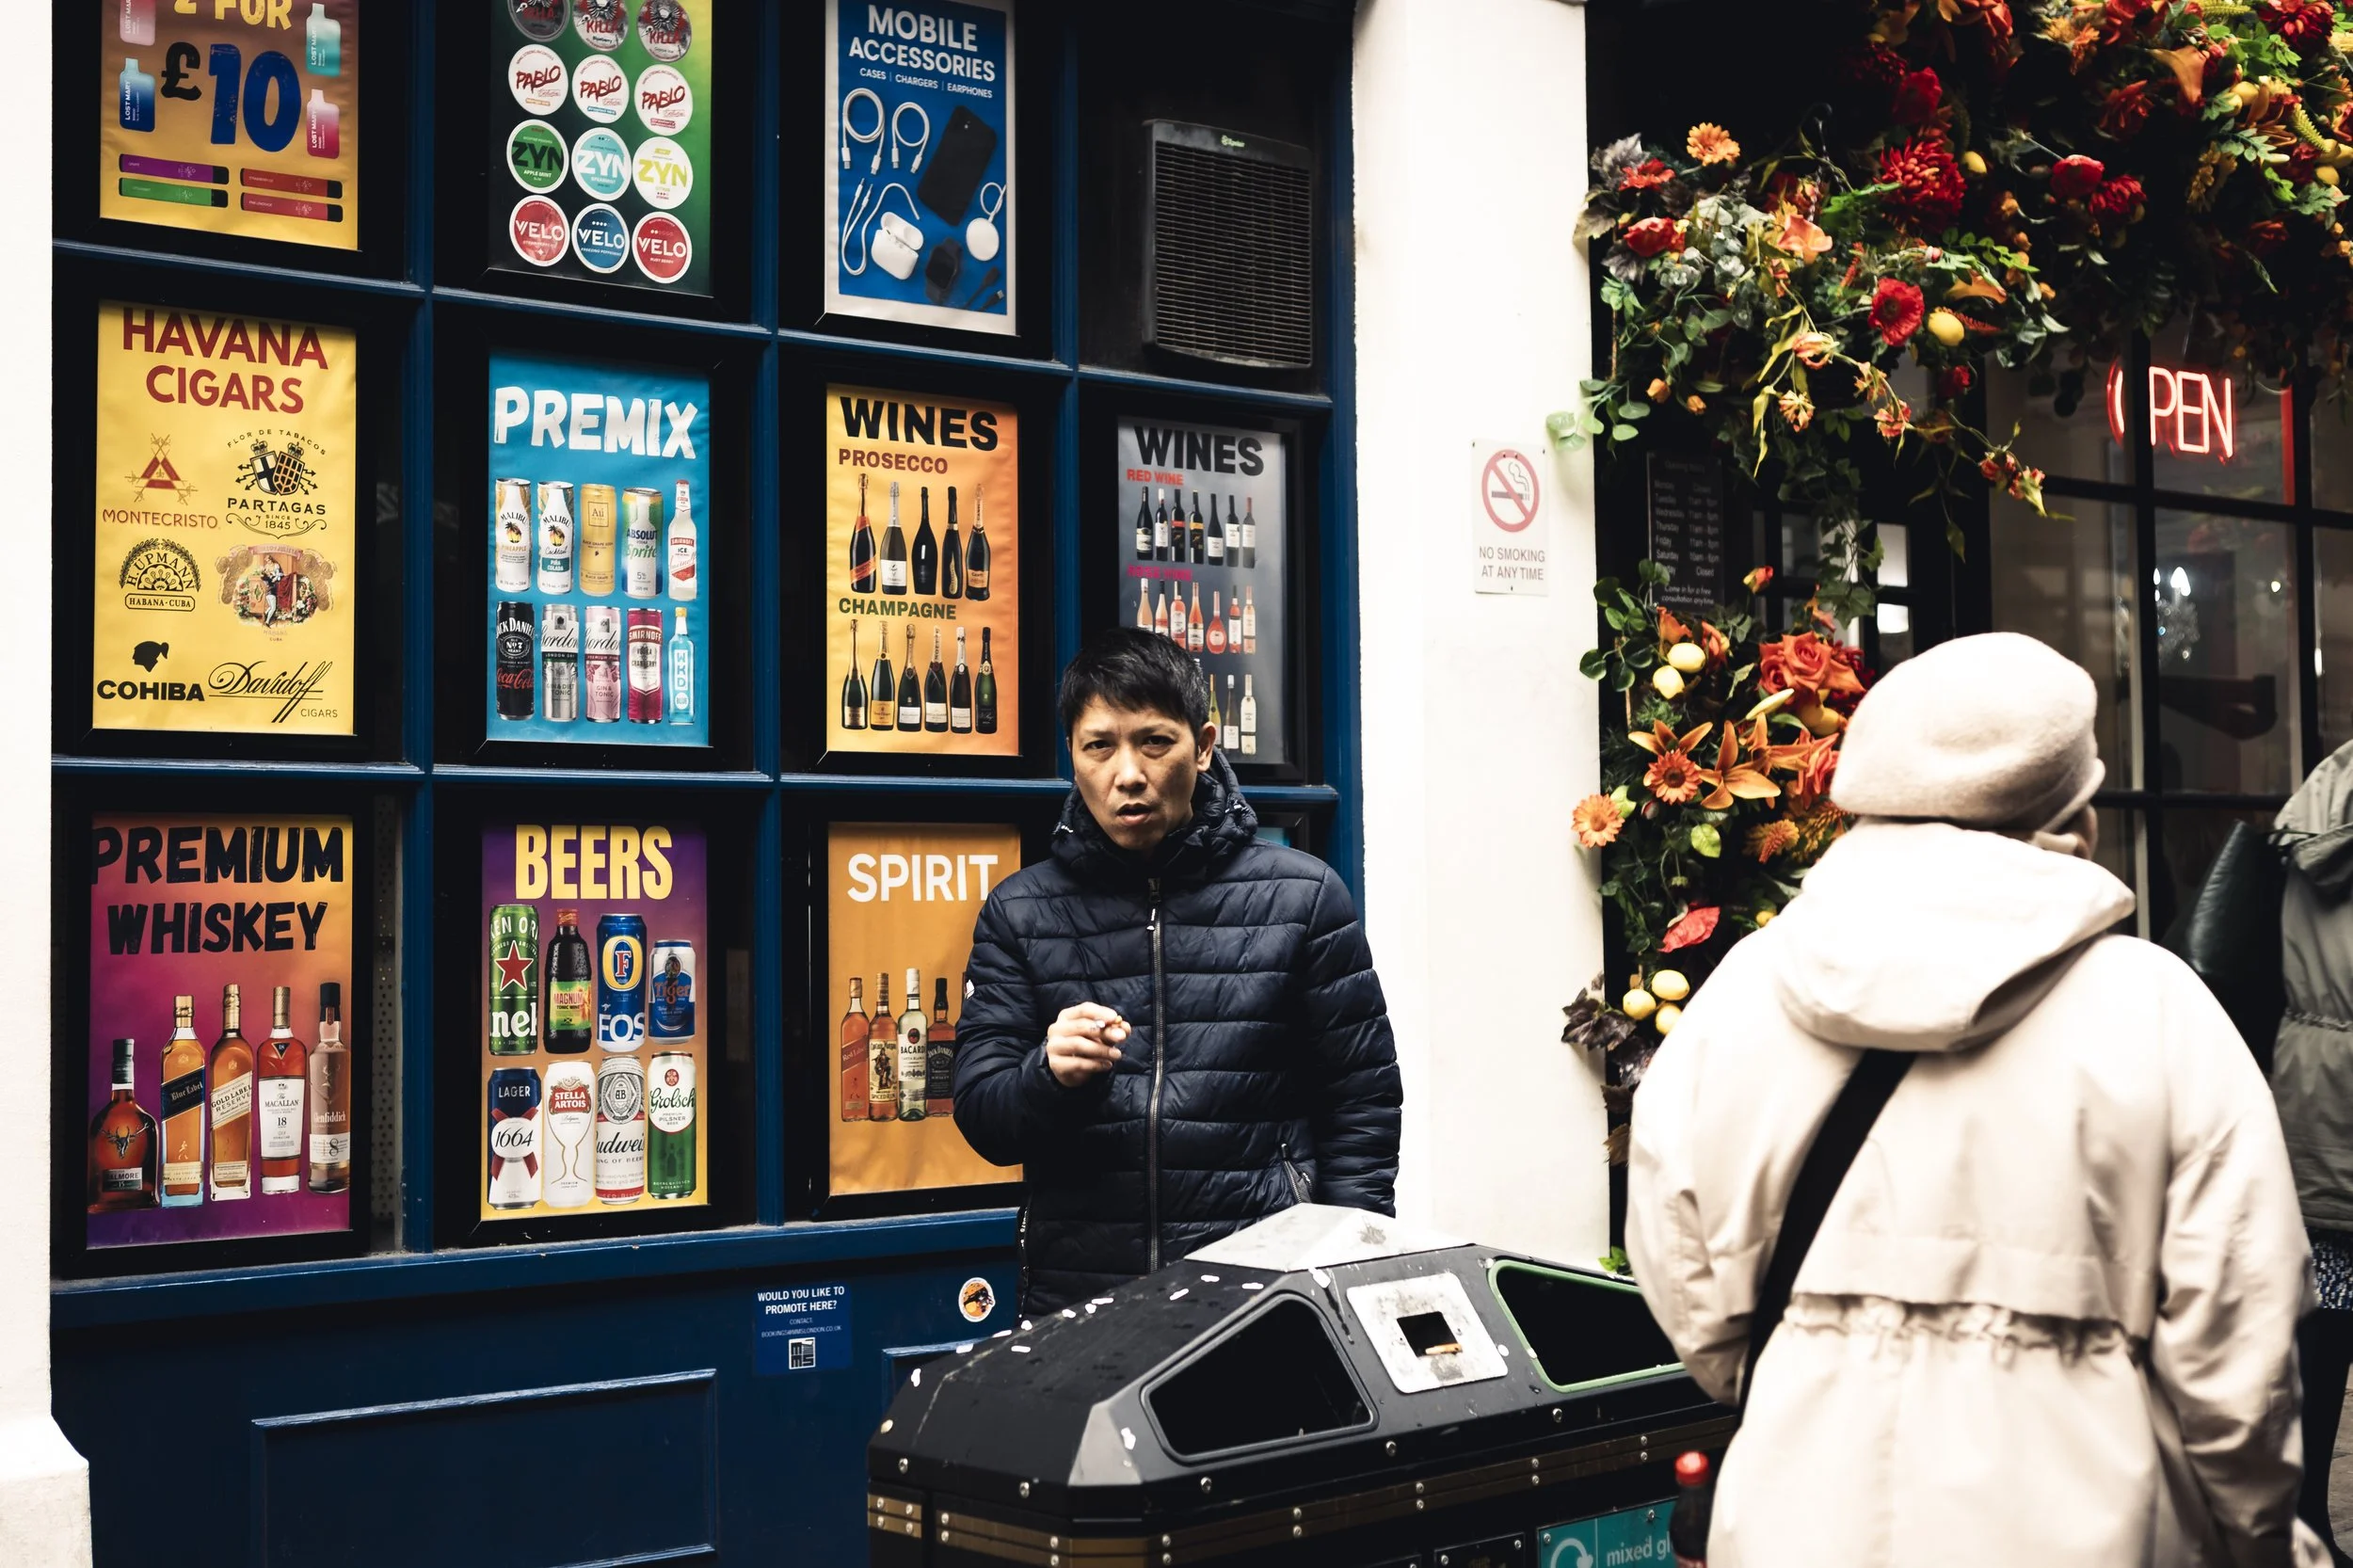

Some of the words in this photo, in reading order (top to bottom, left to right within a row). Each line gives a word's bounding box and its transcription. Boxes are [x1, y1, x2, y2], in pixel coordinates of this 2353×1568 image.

[585, 19, 618, 34] KILLA
[649, 29, 680, 44] KILLA
[868, 5, 978, 52] MOBILE
[849, 37, 996, 82] ACCESSORIES
[516, 65, 562, 93] PABLO
[580, 75, 622, 103] PABLO
[859, 68, 887, 80] CASES
[895, 74, 938, 88] CHARGERS
[947, 83, 993, 99] EARPHONES
[161, 41, 301, 152] £10
[642, 85, 686, 114] PABLO
[512, 140, 565, 171] ZYN
[577, 150, 627, 181] ZYN
[638, 158, 688, 188] ZYN
[515, 219, 565, 242] VELO
[577, 228, 625, 249] VELO
[637, 237, 687, 259] VELO
[122, 307, 328, 370] HAVANA
[146, 364, 305, 414] CIGARS
[494, 386, 698, 459] PREMIX
[2114, 365, 2234, 458] PEN
[840, 395, 999, 452] WINES
[227, 432, 252, 448] FLOR
[280, 429, 327, 456] TABACOS
[1134, 425, 1264, 476] WINES
[839, 448, 949, 474] PROSECCO
[1127, 469, 1151, 482] RED
[1155, 472, 1184, 486] WINE
[228, 498, 326, 515] PARTAGAS
[500, 511, 527, 524] MALIBU
[102, 508, 219, 530] MONTECRISTO
[264, 520, 291, 530] 1845
[543, 515, 570, 527] MALIBU
[1656, 520, 1679, 534] Thursday
[626, 528, 658, 540] ABSOLUT
[1656, 535, 1673, 549] Friday
[1479, 546, 1494, 559] NO
[1497, 548, 1545, 563] SMOKING
[1656, 549, 1679, 562] Saturday
[1481, 565, 1495, 577] AT
[1497, 566, 1518, 579] ANY
[1520, 568, 1545, 581] TIME
[1696, 566, 1715, 577] Closed
[129, 597, 165, 607] HABANA
[169, 599, 191, 608] CUBA
[839, 598, 957, 620] CHAMPAGNE
[629, 631, 662, 642] SMIRNOFF
[677, 652, 685, 687] WKD
[97, 680, 205, 701] COHIBA
[208, 661, 333, 724] Davidoff
[300, 708, 338, 719] CIGARS
[91, 826, 344, 885] PREMIUM
[515, 824, 674, 900] BEERS
[847, 854, 998, 903] SPIRIT
[107, 902, 328, 955] WHISKEY
[553, 993, 584, 1004] MAGNUM
[654, 980, 691, 1004] Tiger
[171, 1089, 186, 1101] Blue
[186, 1081, 203, 1096] Label
[211, 1094, 230, 1108] GOLD
[231, 1083, 252, 1098] LABEL
[498, 1086, 531, 1097] LAGER
[554, 1092, 585, 1100] STELLA
[649, 1087, 696, 1113] Grolsch
[216, 1093, 250, 1112] RESERVE
[264, 1099, 299, 1108] MACALLAN
[554, 1100, 586, 1109] ARTOIS
[277, 1117, 287, 1127] 18
[495, 1128, 534, 1147] 1664
[758, 1290, 790, 1302] WOULD
[791, 1288, 809, 1299] YOU
[811, 1287, 831, 1298] LIKE
[833, 1286, 845, 1296] TO
[765, 1303, 808, 1315] PROMOTE
[809, 1300, 838, 1311] HERE?
[1607, 1534, 1653, 1567] mixed
